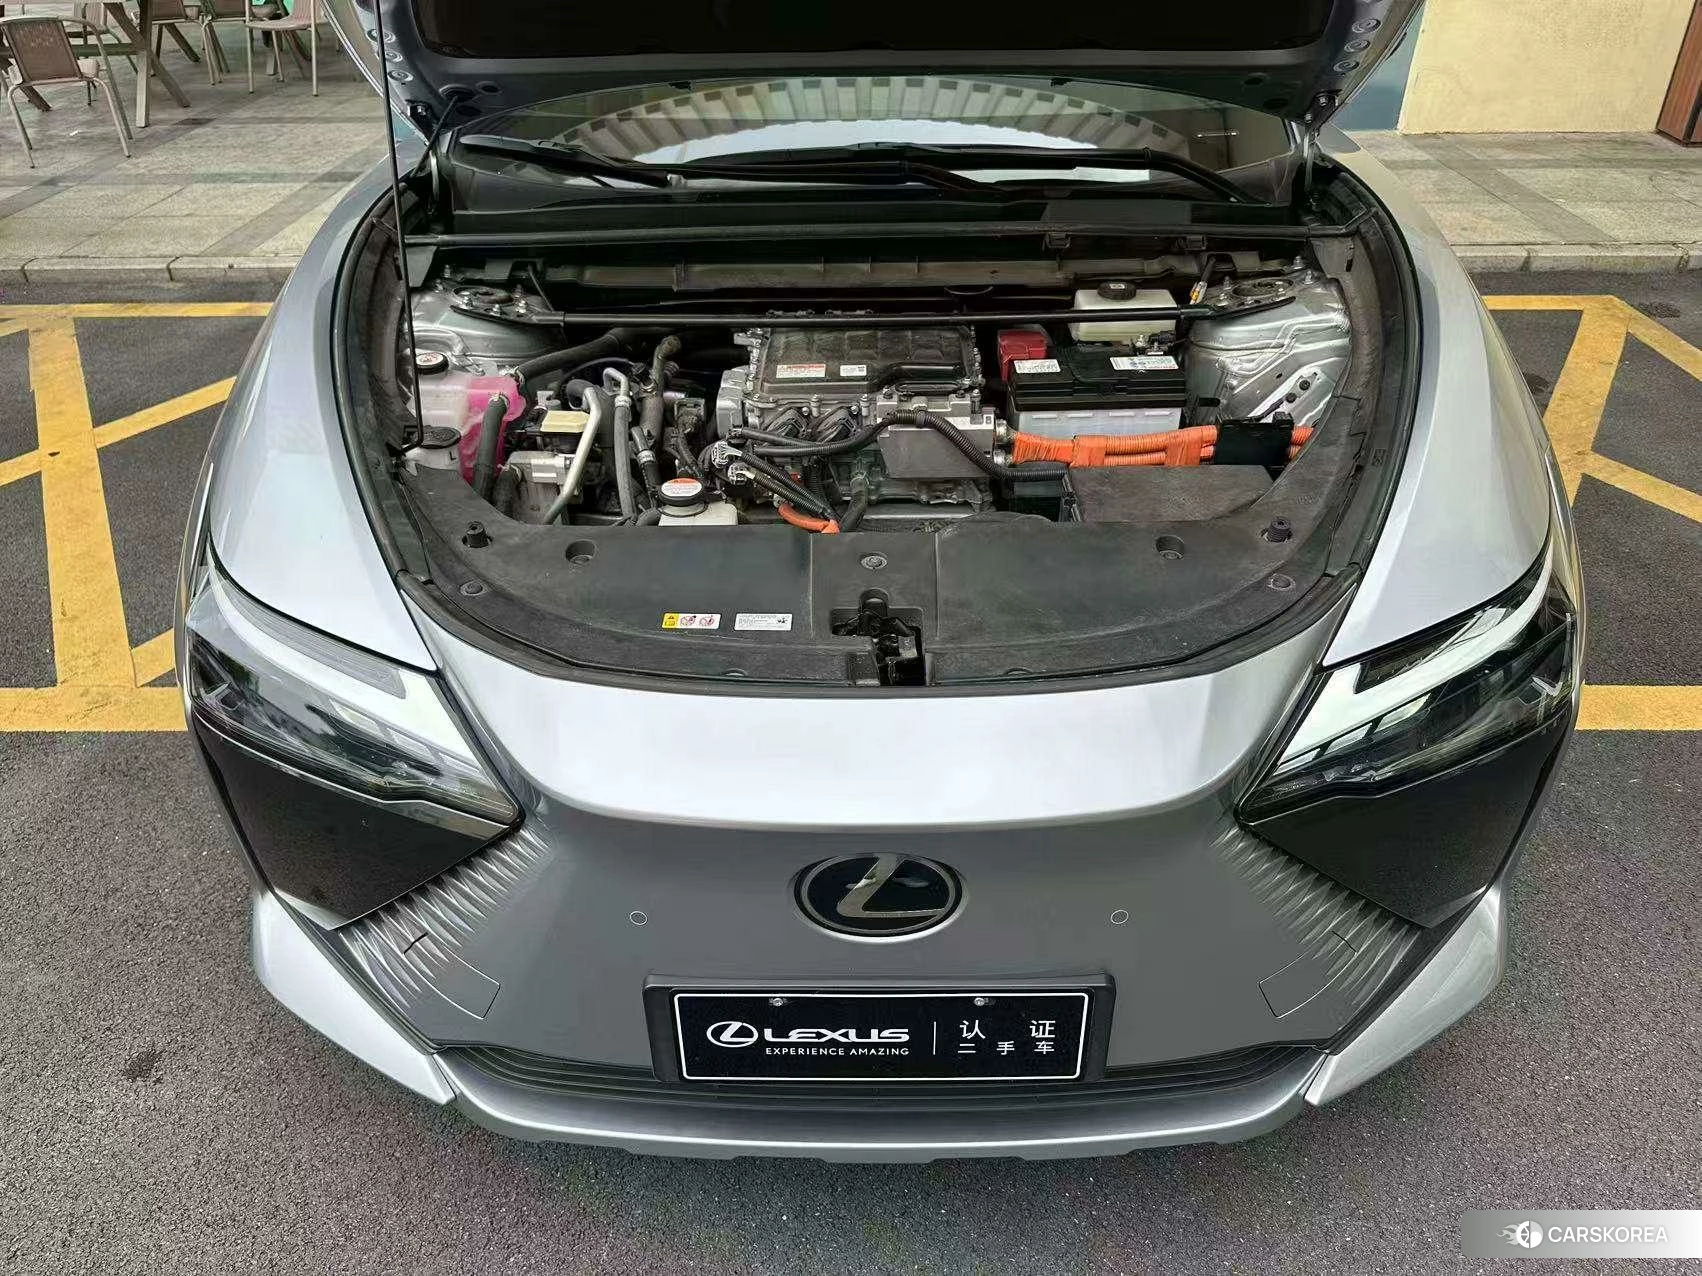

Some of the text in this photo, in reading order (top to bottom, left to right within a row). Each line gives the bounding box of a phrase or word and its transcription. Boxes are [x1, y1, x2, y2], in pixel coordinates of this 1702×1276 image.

[763, 1028, 910, 1043] LEXUS
[765, 1047, 910, 1056] EXPERIENCE AMAZING
